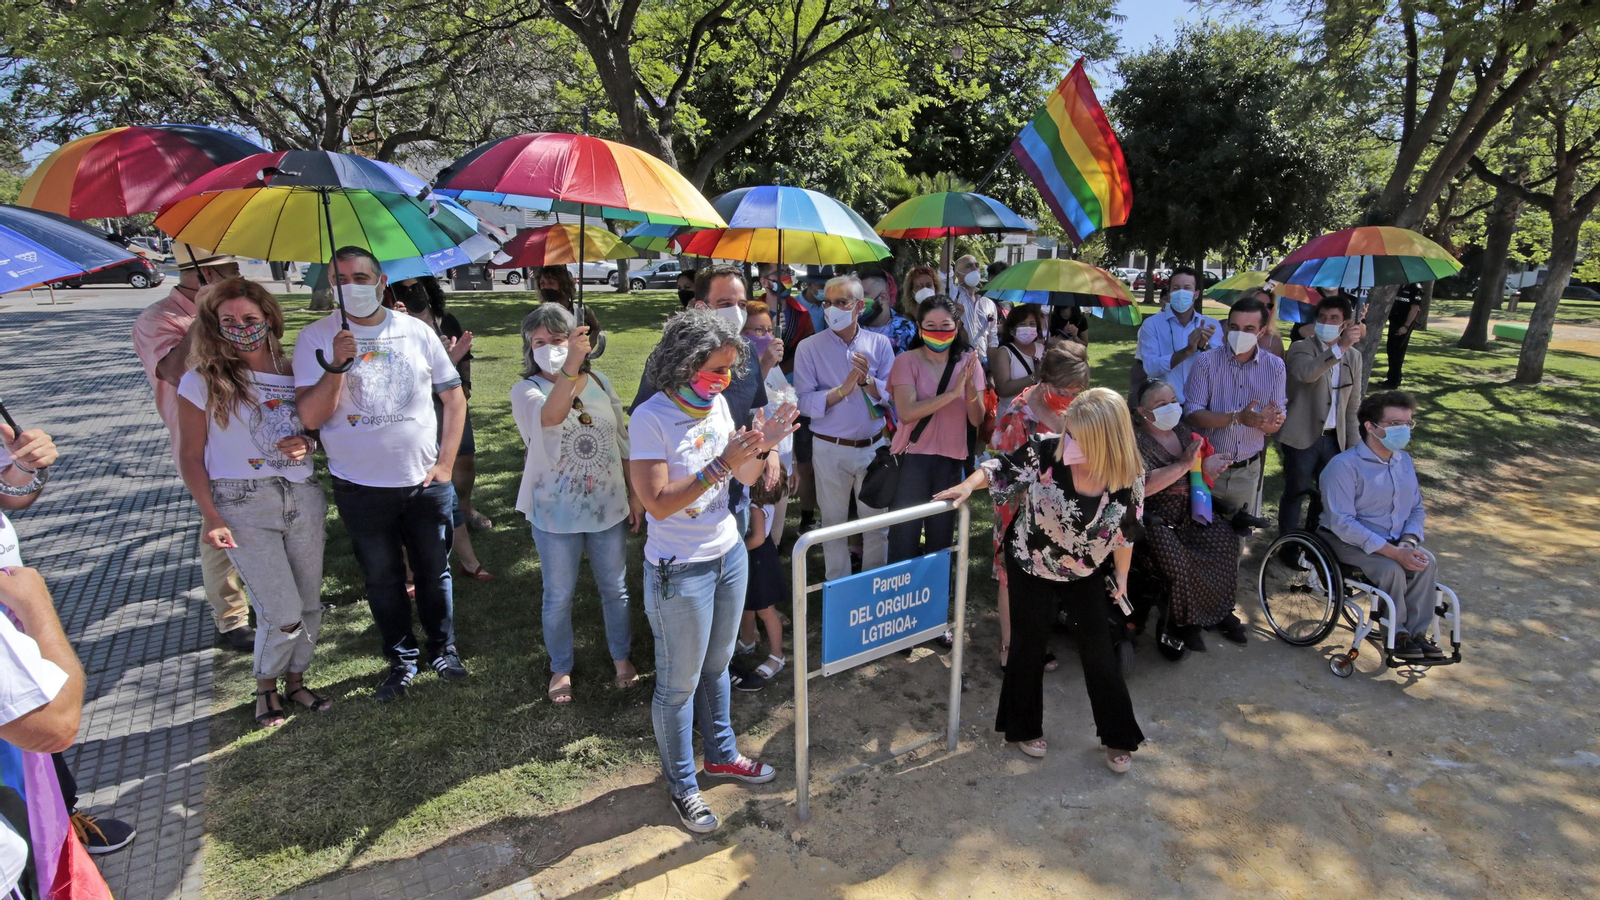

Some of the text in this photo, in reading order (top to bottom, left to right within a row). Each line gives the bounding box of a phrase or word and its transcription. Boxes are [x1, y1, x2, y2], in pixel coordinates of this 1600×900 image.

[361, 413, 404, 426] ORGULLO
[266, 459, 302, 470] ORGULLO
[873, 572, 911, 595] Parque
[849, 586, 930, 627] DEL ORGULLO
[862, 615, 918, 645] LGTBIQA+
